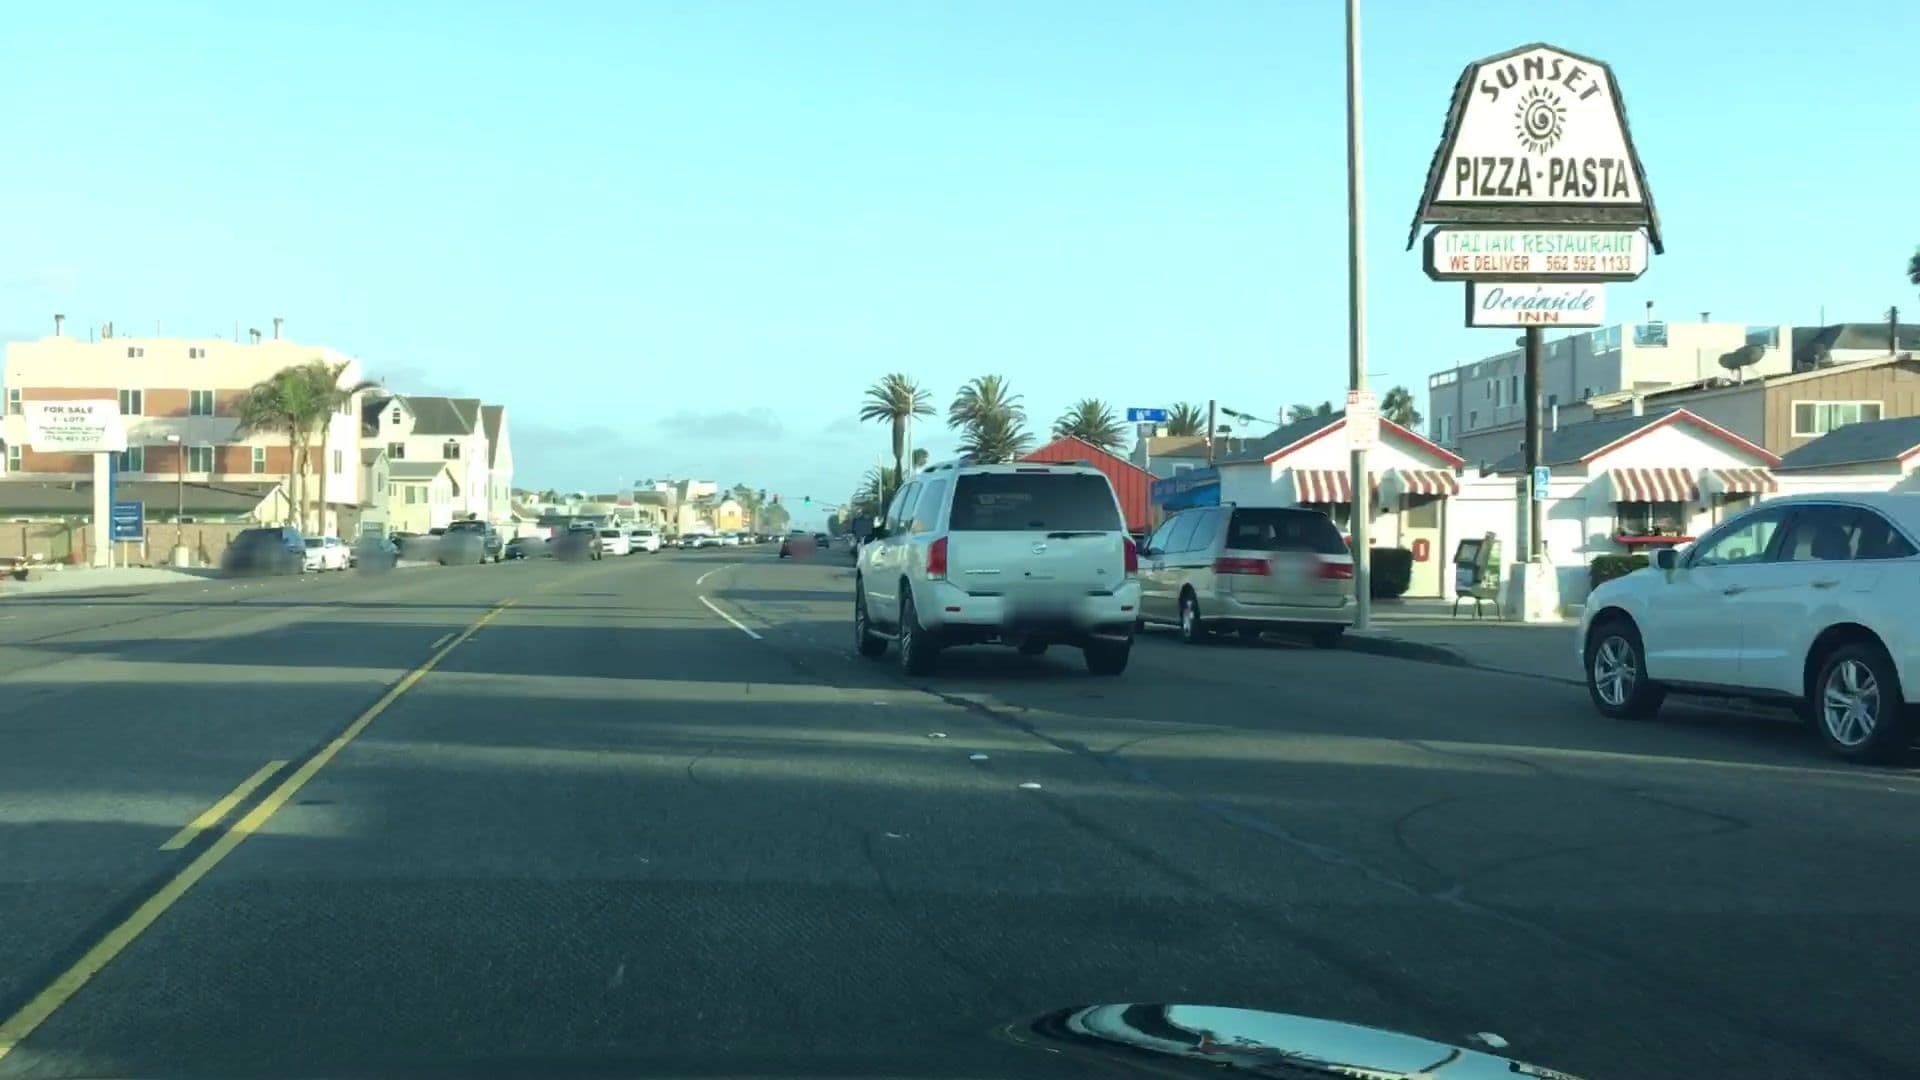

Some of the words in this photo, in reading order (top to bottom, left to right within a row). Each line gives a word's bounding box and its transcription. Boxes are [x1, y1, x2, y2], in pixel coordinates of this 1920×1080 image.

[1480, 56, 1602, 102] SUNSET
[1455, 157, 1533, 196] PIZZA
[1549, 157, 1630, 198] PASTA
[1446, 235, 1515, 253] ITALIAN
[1522, 234, 1633, 253] RESTAURANT
[1450, 255, 1470, 271] WE
[1474, 255, 1529, 271] DELIVER
[1546, 255, 1569, 271] 562
[1573, 255, 1596, 271] 592
[1601, 255, 1631, 271] 1133
[1482, 287, 1595, 310] Oceanside
[1517, 311, 1559, 322] INN
[43, 406, 65, 414] FOR
[69, 406, 94, 414] SALE
